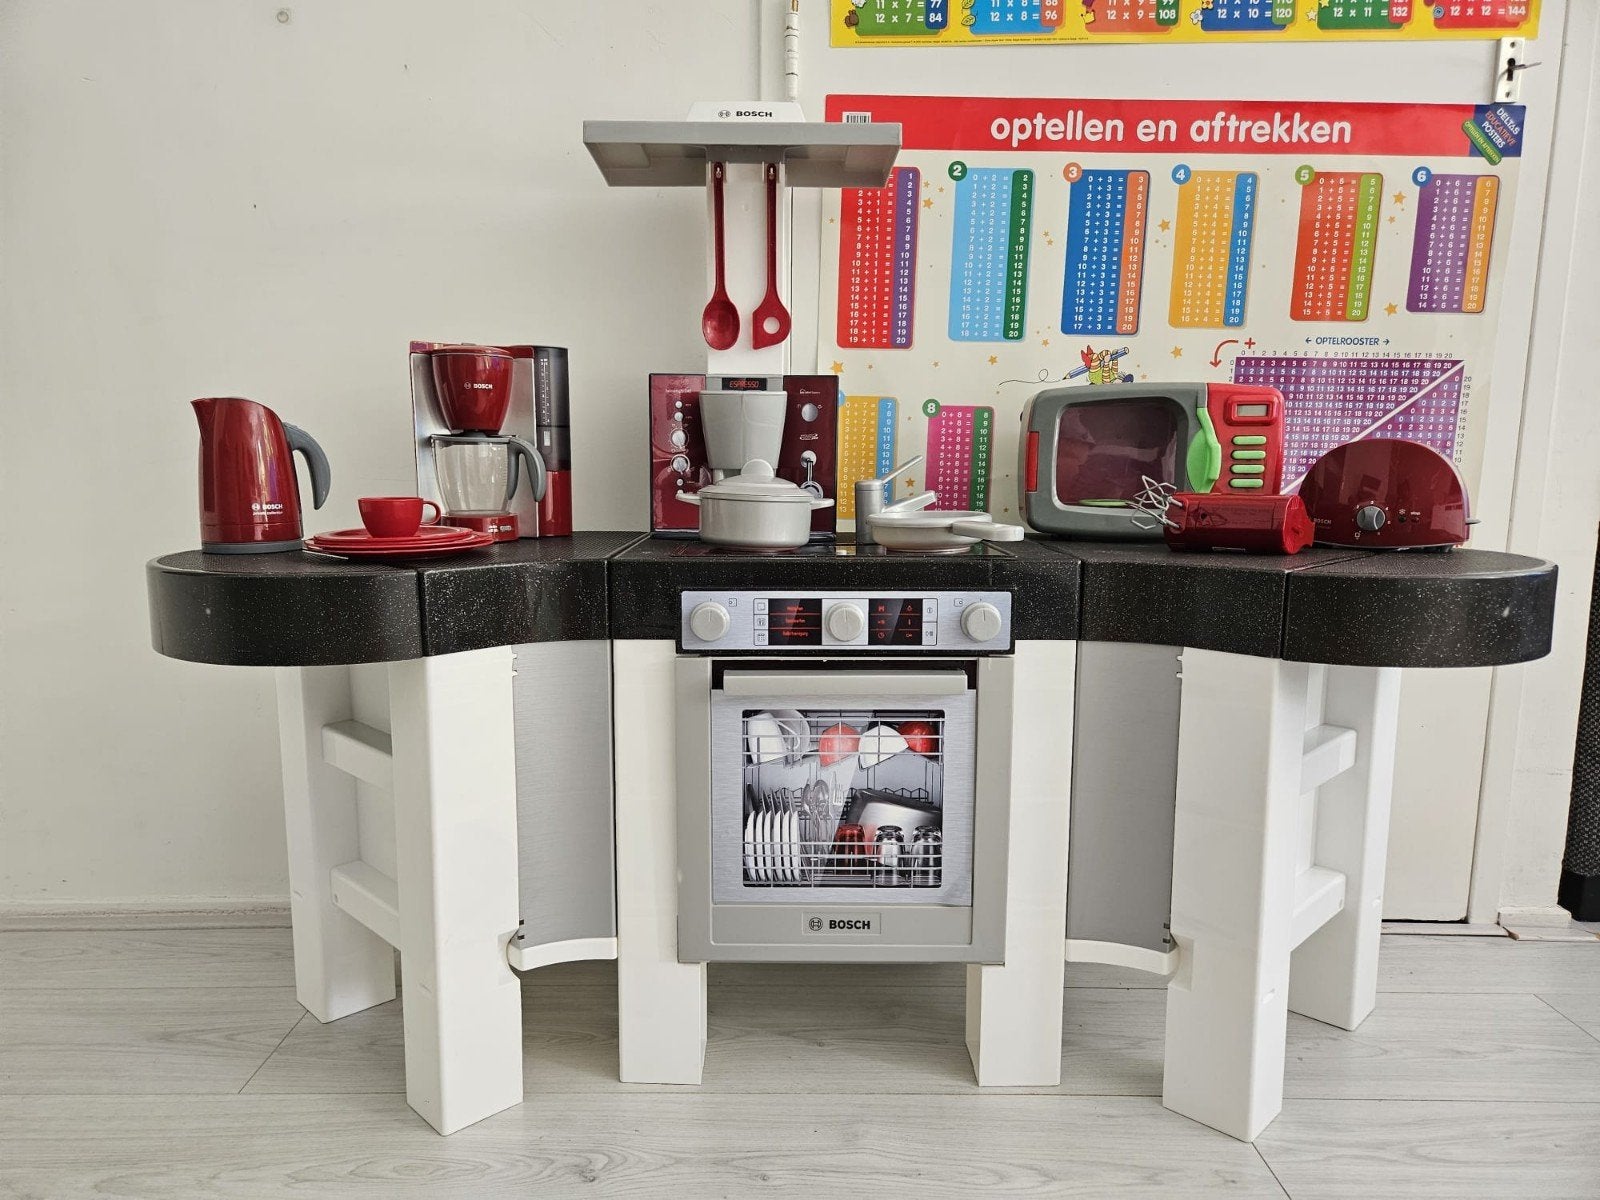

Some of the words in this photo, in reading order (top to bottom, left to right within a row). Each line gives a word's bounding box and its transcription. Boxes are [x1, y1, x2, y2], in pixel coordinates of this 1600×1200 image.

[876, 0, 885, 9] 11
[906, 0, 912, 8] 7
[930, 0, 941, 8] 77
[990, 12, 1000, 21] 12
[1006, 13, 1013, 21] x
[1021, 11, 1027, 21] 8
[1045, 10, 1057, 20] 96
[1107, 10, 1116, 20] 12
[1137, 10, 1144, 19] 9
[1159, 9, 1176, 19] 108
[1217, 8, 1227, 18] 12
[1248, 8, 1259, 18] 10
[1276, 8, 1292, 18] 120
[1333, 7, 1343, 17] 12
[1349, 9, 1356, 17] x
[1364, 7, 1372, 17] 11
[1392, 7, 1408, 17] 132
[1450, 6, 1460, 16] 12
[1466, 8, 1473, 16] x
[1481, 5, 1491, 15] 12
[1508, 6, 1525, 15] 144
[875, 13, 885, 23] 12
[906, 13, 912, 23] 7
[929, 13, 942, 22] 84
[736, 110, 773, 118] BOSCH
[1496, 107, 1520, 135] DELTAS
[991, 110, 1124, 148] optellen
[1137, 119, 1177, 142] en
[1190, 111, 1351, 143] aftrekken
[1484, 110, 1517, 146] EDUCATIEVE
[1482, 121, 1506, 148] POSTERS
[953, 165, 962, 176] 2
[1069, 167, 1077, 178] 3
[1176, 169, 1185, 180] 4
[1300, 170, 1309, 181] 5
[1417, 170, 1426, 182] 6
[1315, 336, 1380, 346] OPTELROOSTER
[729, 380, 759, 388] ESPRESSO
[927, 403, 935, 413] 8
[829, 919, 871, 930] BOSCH
